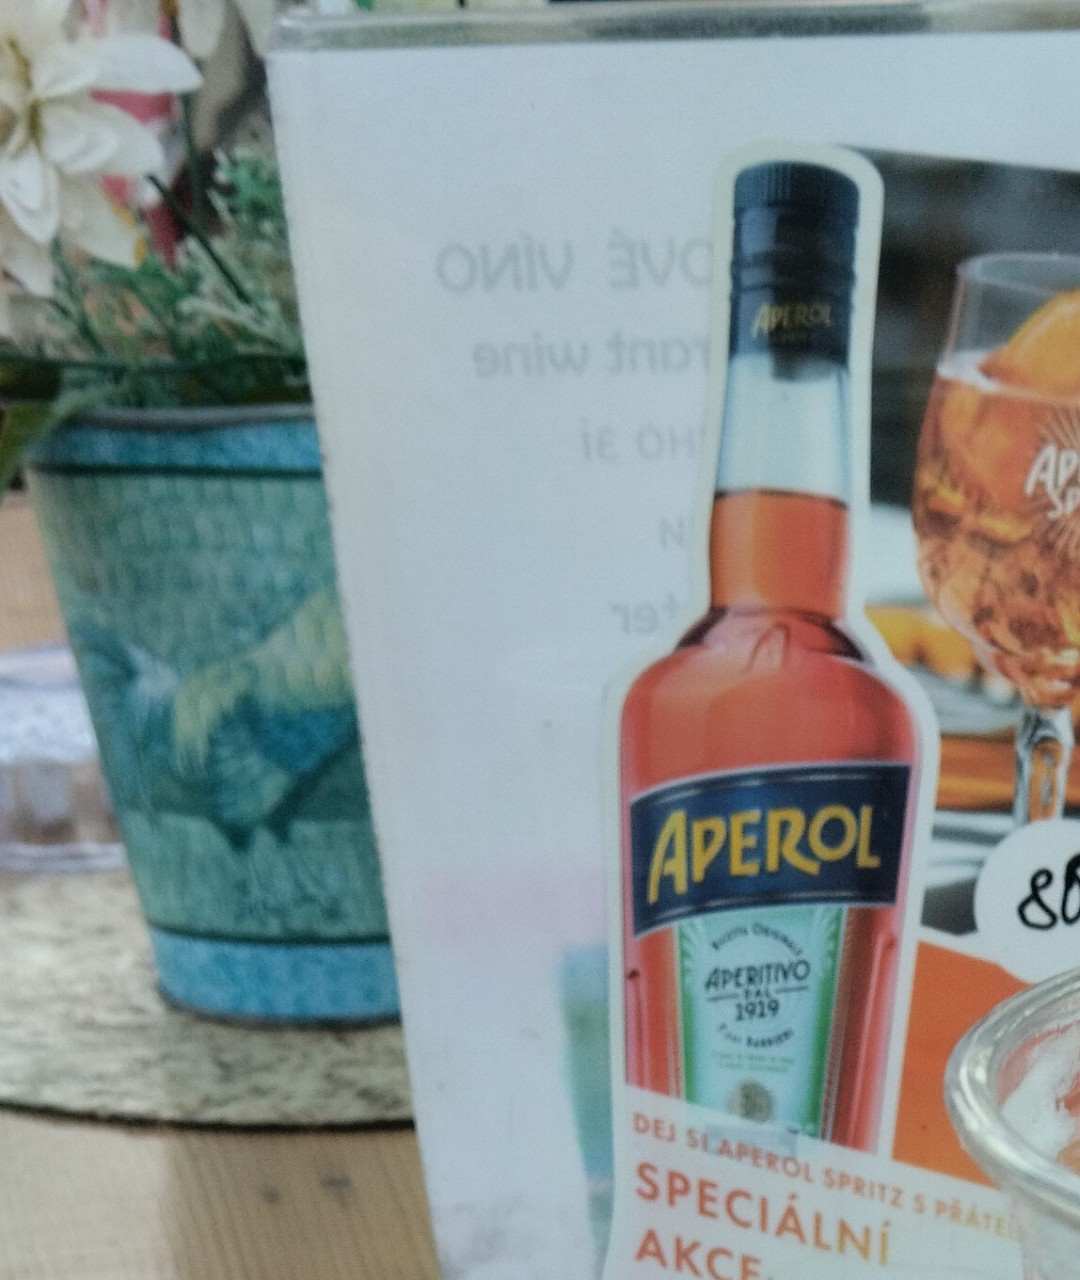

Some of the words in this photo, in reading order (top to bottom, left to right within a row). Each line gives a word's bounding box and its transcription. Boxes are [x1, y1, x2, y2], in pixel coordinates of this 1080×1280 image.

[646, 804, 881, 906] APEROL
[704, 959, 811, 992] APERITIVO
[735, 998, 780, 1021] 1919
[633, 1112, 677, 1142] DEJ
[686, 1128, 709, 1152] SI
[717, 1137, 814, 1184] APEROL
[823, 1168, 905, 1208] SPRITZ
[912, 1193, 927, 1215] S
[636, 1161, 892, 1266] SPECIÁLNÍ
